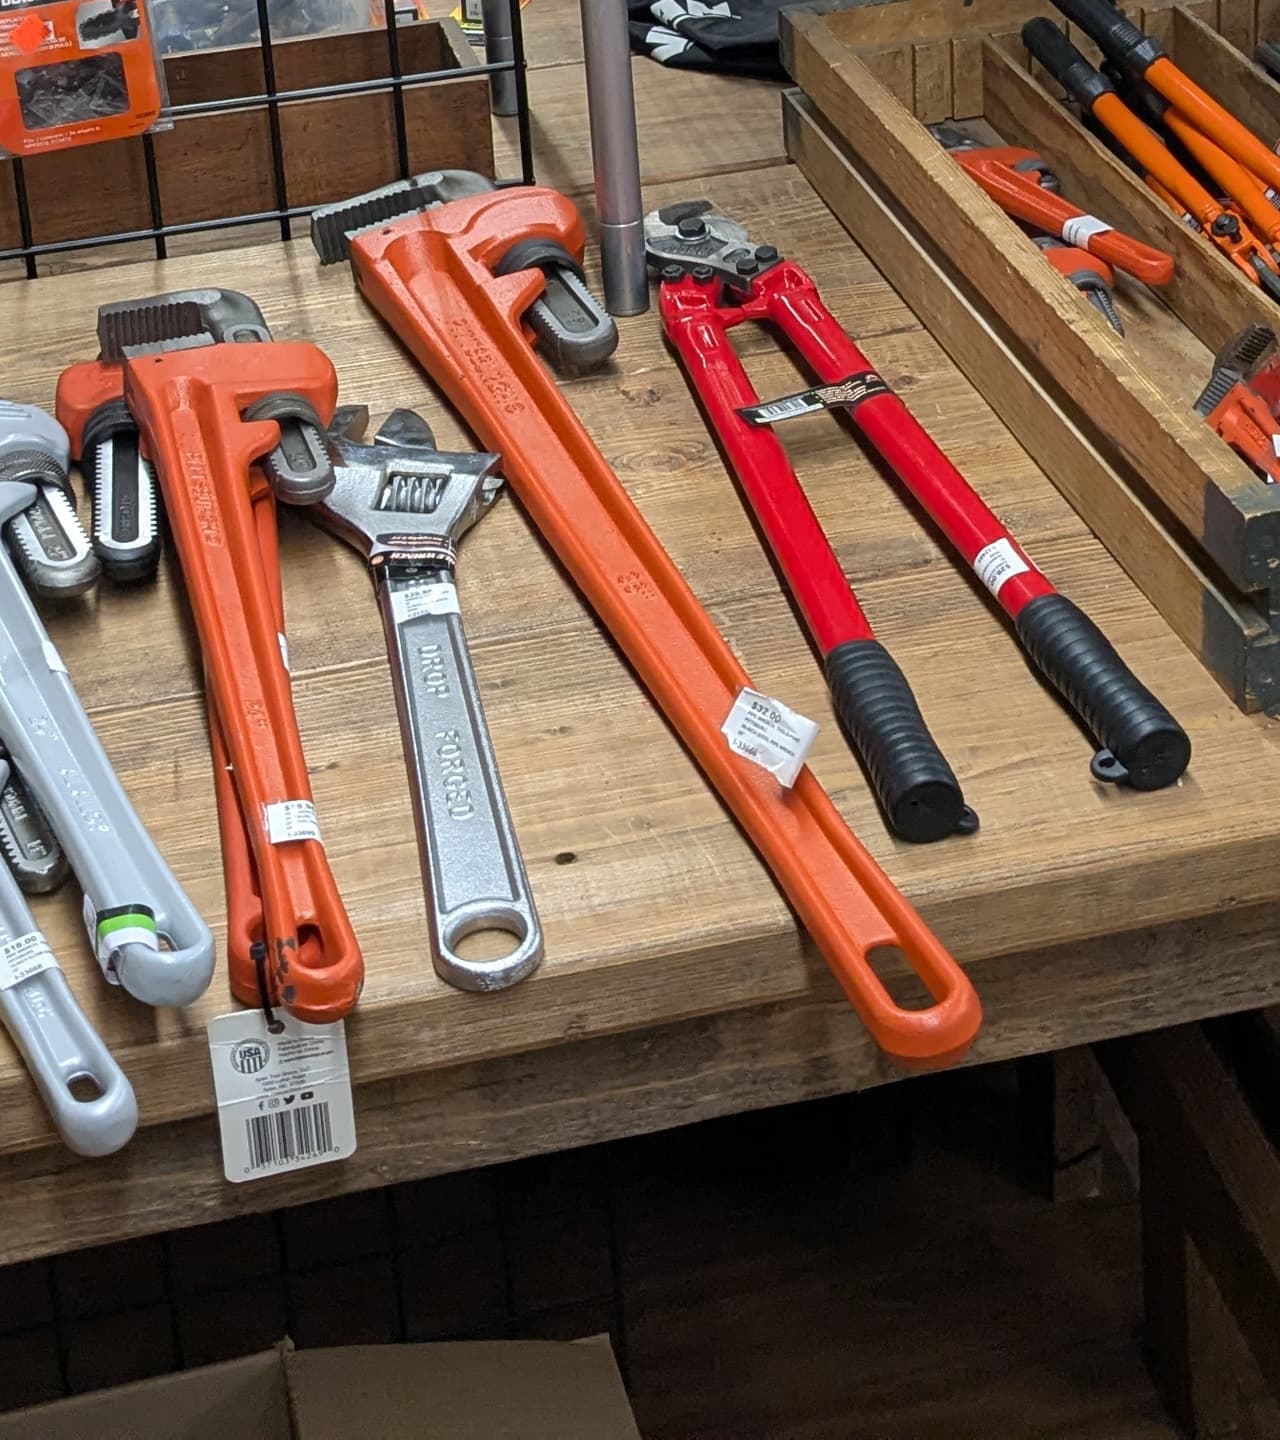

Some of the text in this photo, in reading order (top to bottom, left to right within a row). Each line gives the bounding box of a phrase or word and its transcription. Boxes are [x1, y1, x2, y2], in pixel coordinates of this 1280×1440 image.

[750, 701, 782, 723] $32.00
[419, 643, 475, 822] DROP FORGED
[239, 1047, 261, 1059] USA
